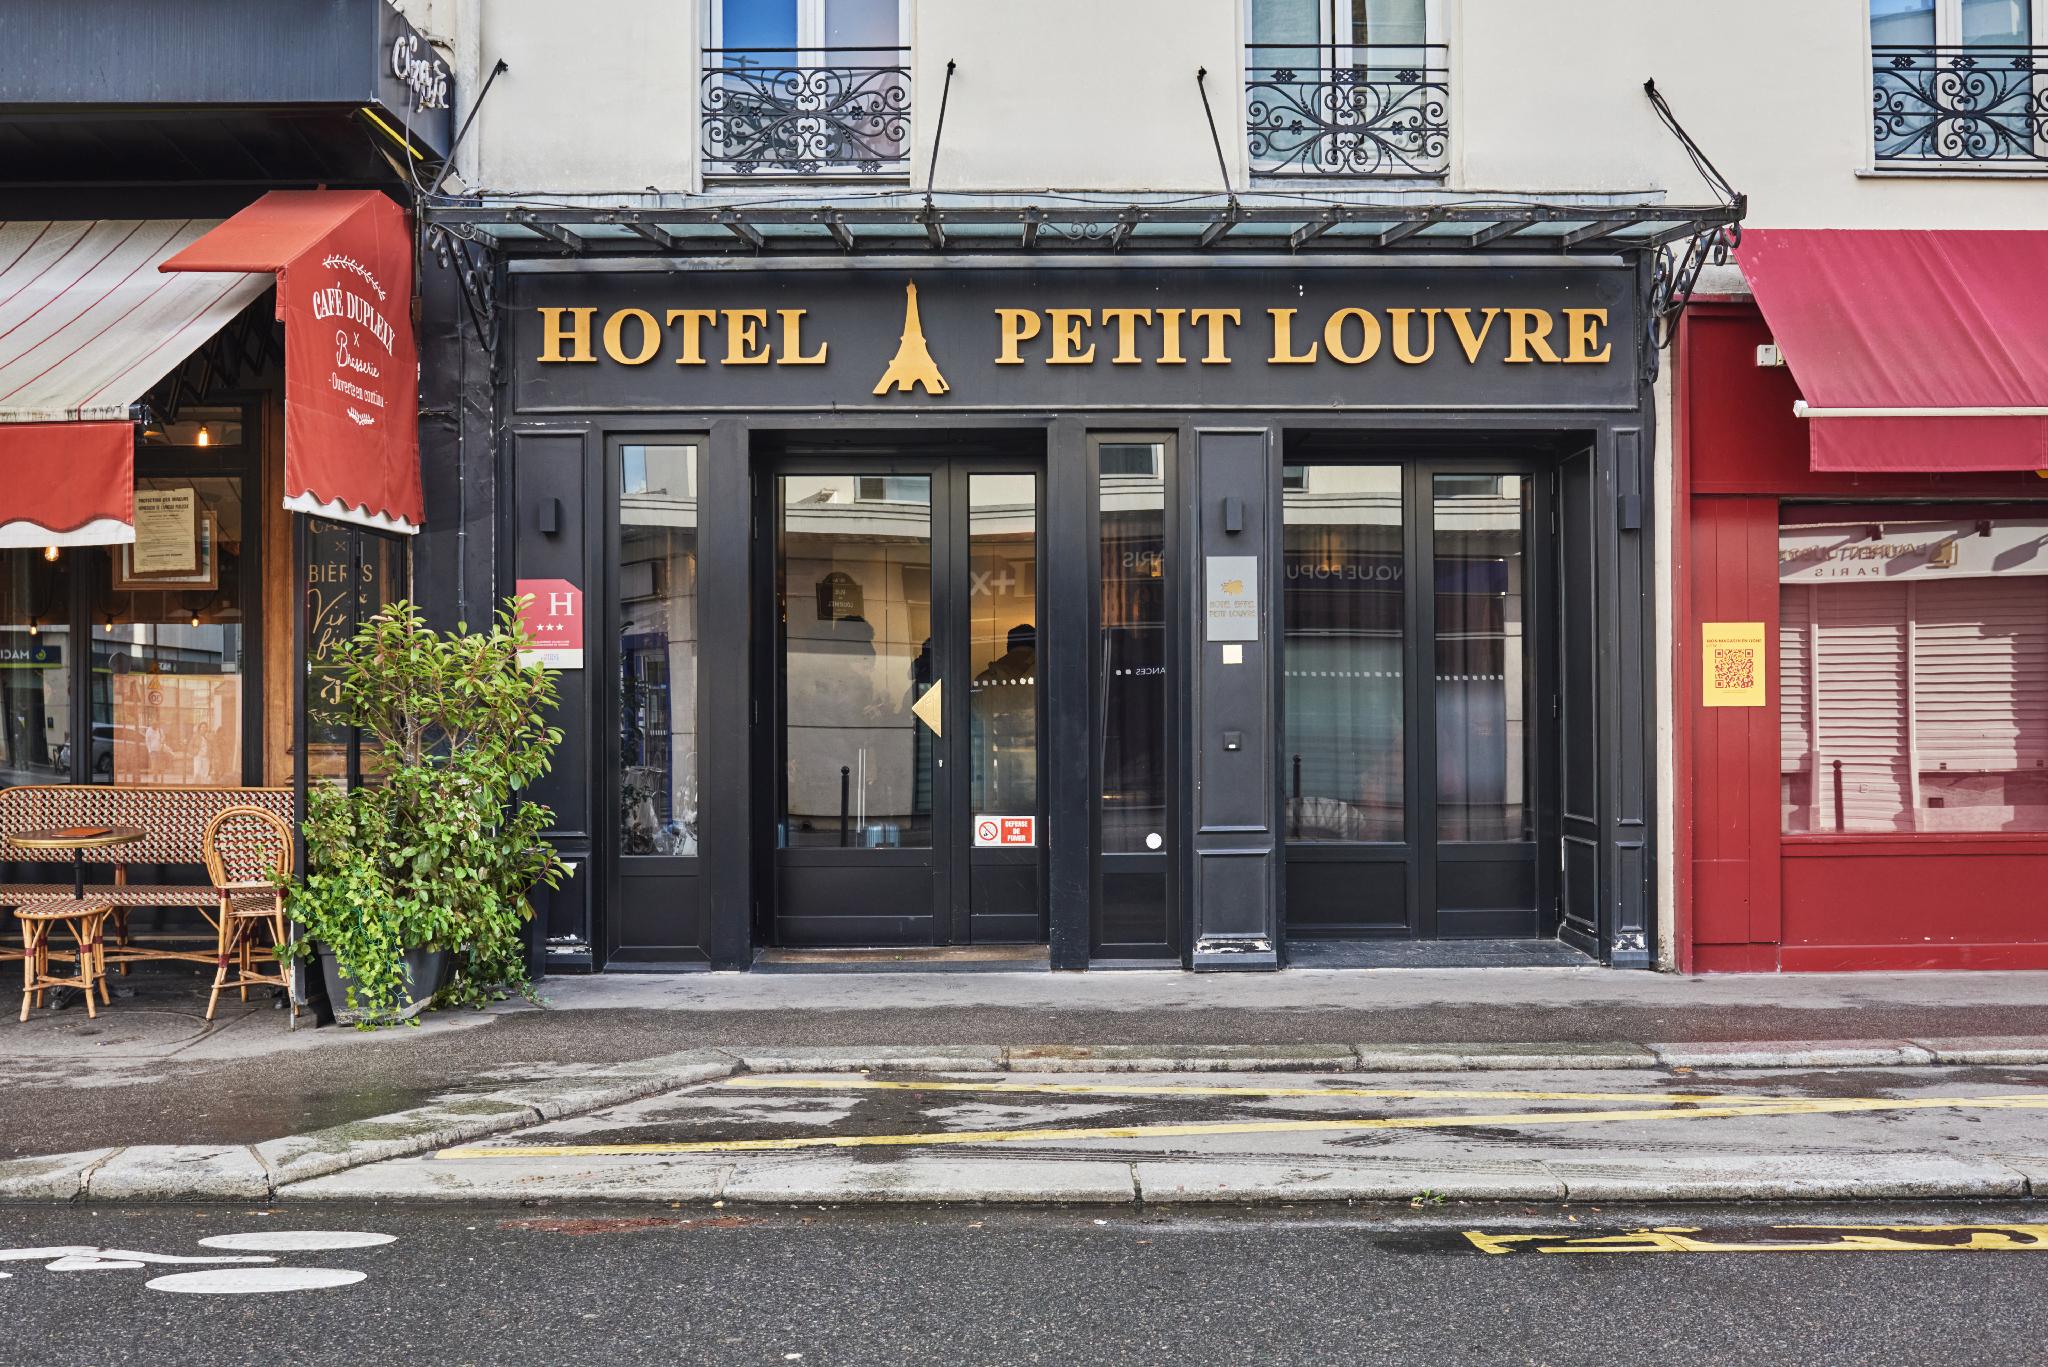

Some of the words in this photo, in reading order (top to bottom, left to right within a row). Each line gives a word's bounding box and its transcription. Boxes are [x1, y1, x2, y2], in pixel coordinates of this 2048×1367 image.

[313, 281, 343, 320] CAFÉ
[346, 291, 395, 357] DUPLEIX
[536, 306, 828, 366] HOTEL
[994, 307, 1241, 366] PETIT
[1267, 307, 1612, 366] LOUVRE
[335, 329, 380, 378] Brasserie
[548, 592, 575, 616] H
